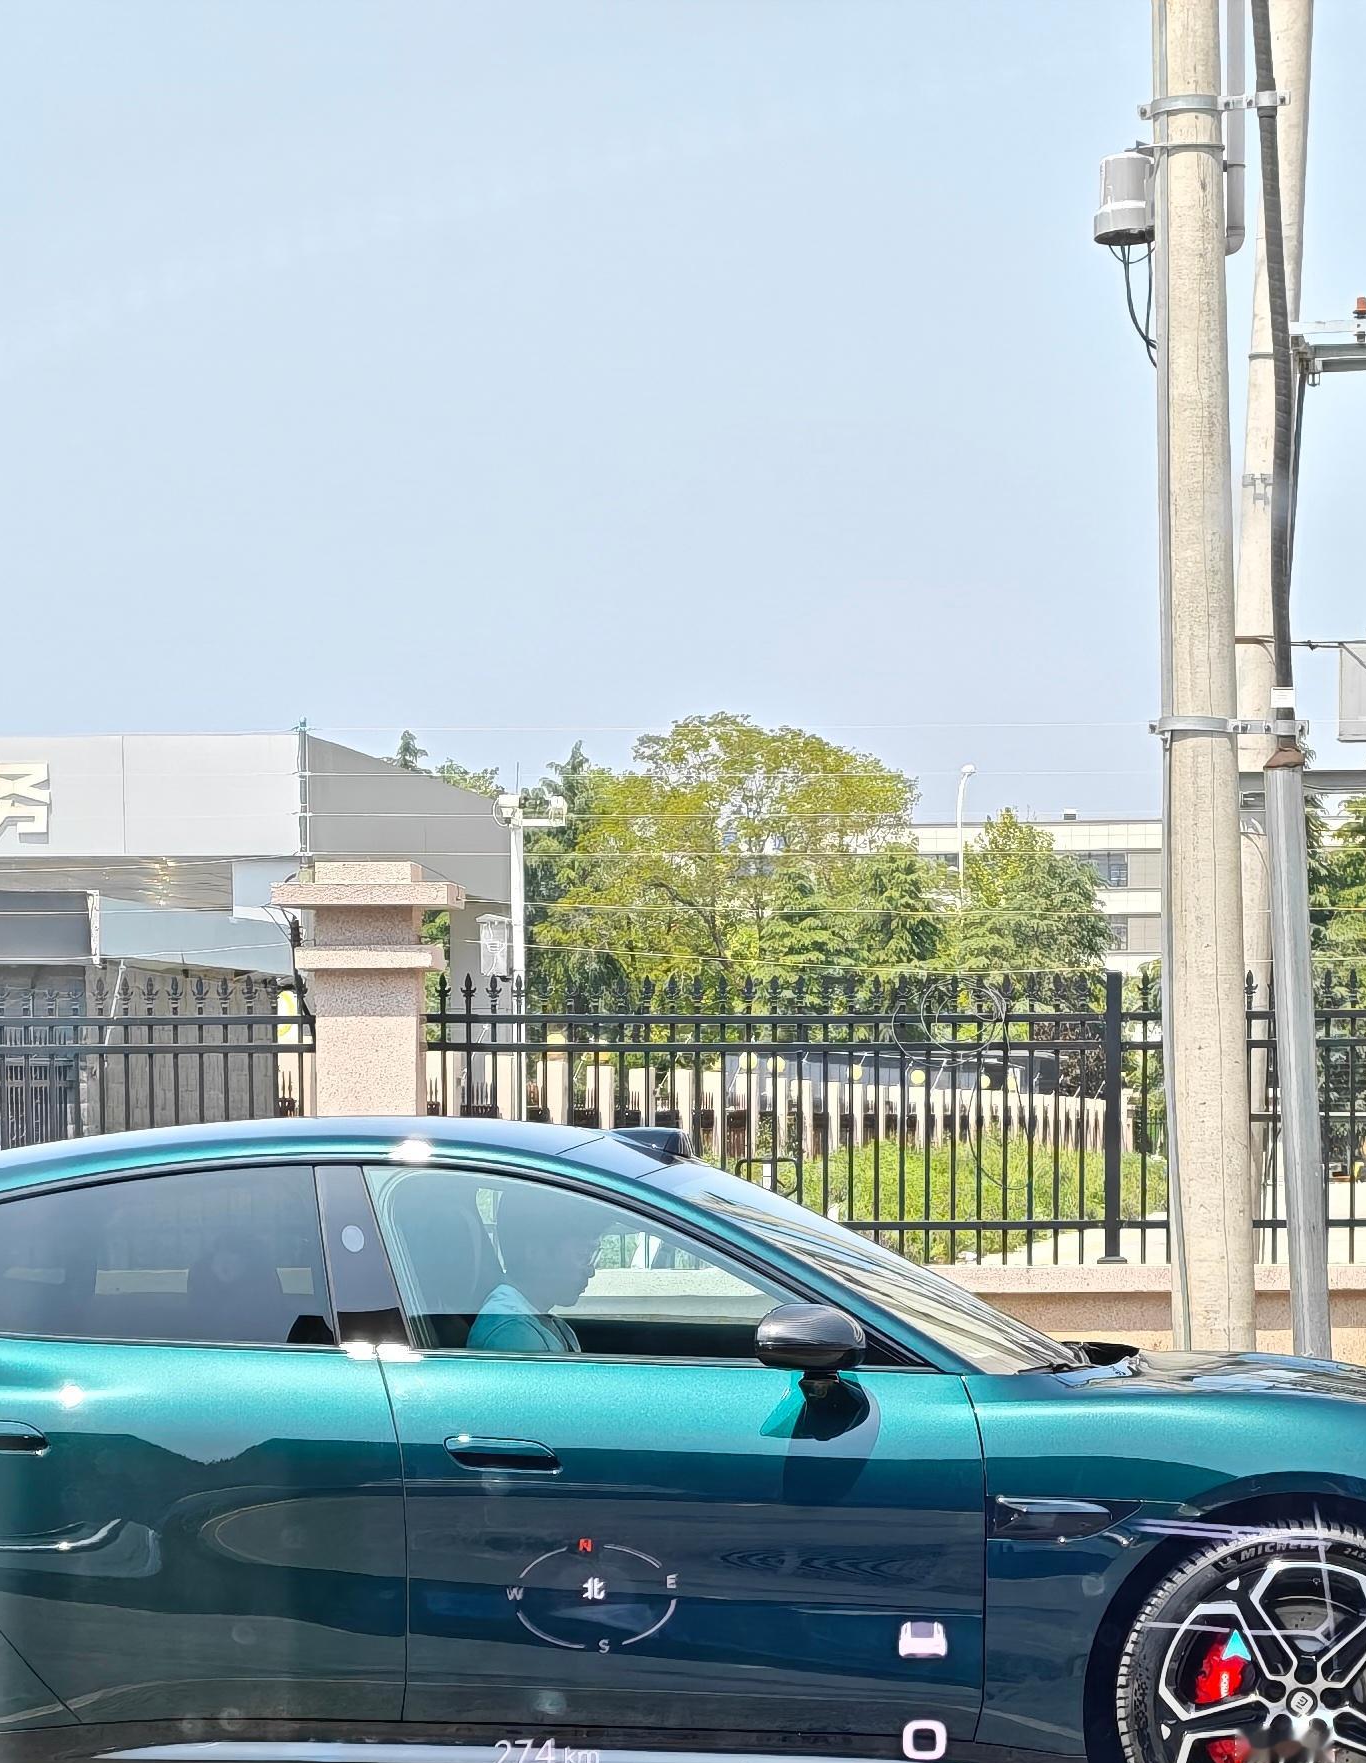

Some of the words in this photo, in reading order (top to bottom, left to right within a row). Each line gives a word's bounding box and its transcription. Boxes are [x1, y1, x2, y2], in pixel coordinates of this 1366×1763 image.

[579, 1538, 592, 1552] N
[582, 1577, 606, 1600] 北
[667, 1573, 678, 1589] E
[506, 1587, 524, 1601] W
[598, 1639, 610, 1654] S
